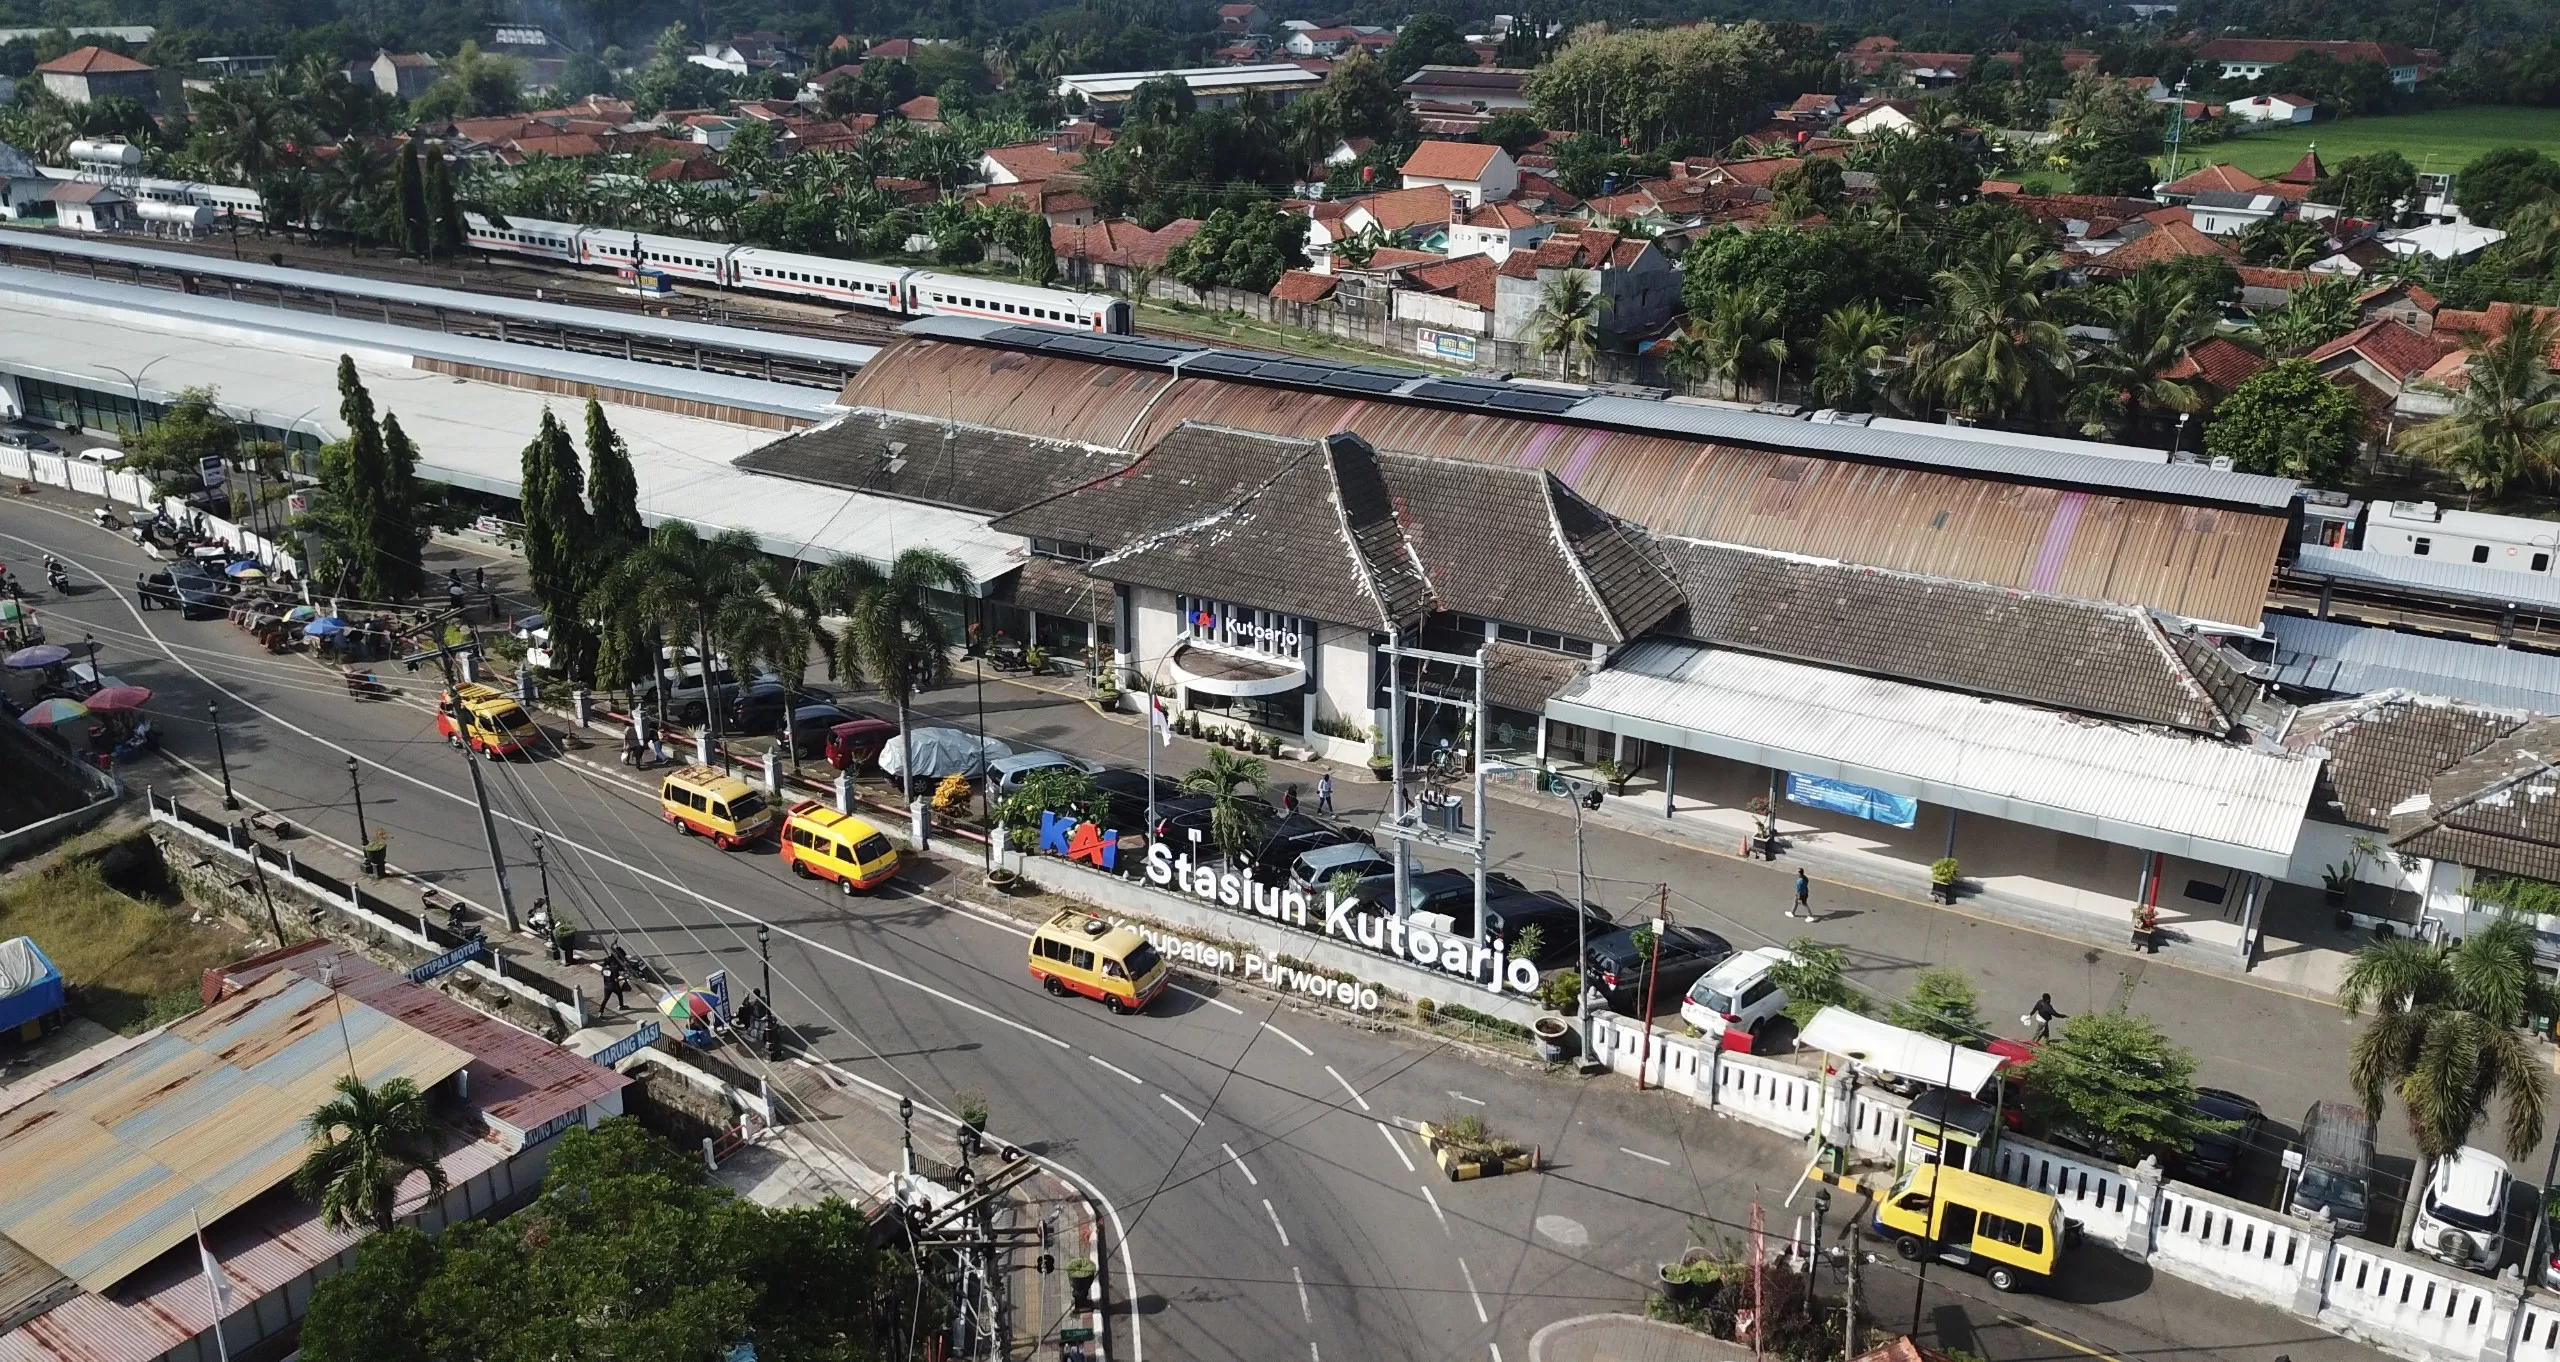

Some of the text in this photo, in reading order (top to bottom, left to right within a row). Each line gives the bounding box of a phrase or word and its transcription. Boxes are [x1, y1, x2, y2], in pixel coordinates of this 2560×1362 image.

[1188, 608, 1298, 648] KAI Kutoarjo
[1040, 810, 1541, 994] KAI Stasiun Kutoarjo
[416, 941, 481, 977] TITIPAN MOTOR
[1244, 953, 1379, 1012] Purworejo
[595, 1023, 659, 1067] WARUNG NASI
[523, 1122, 551, 1150] ARUNG
